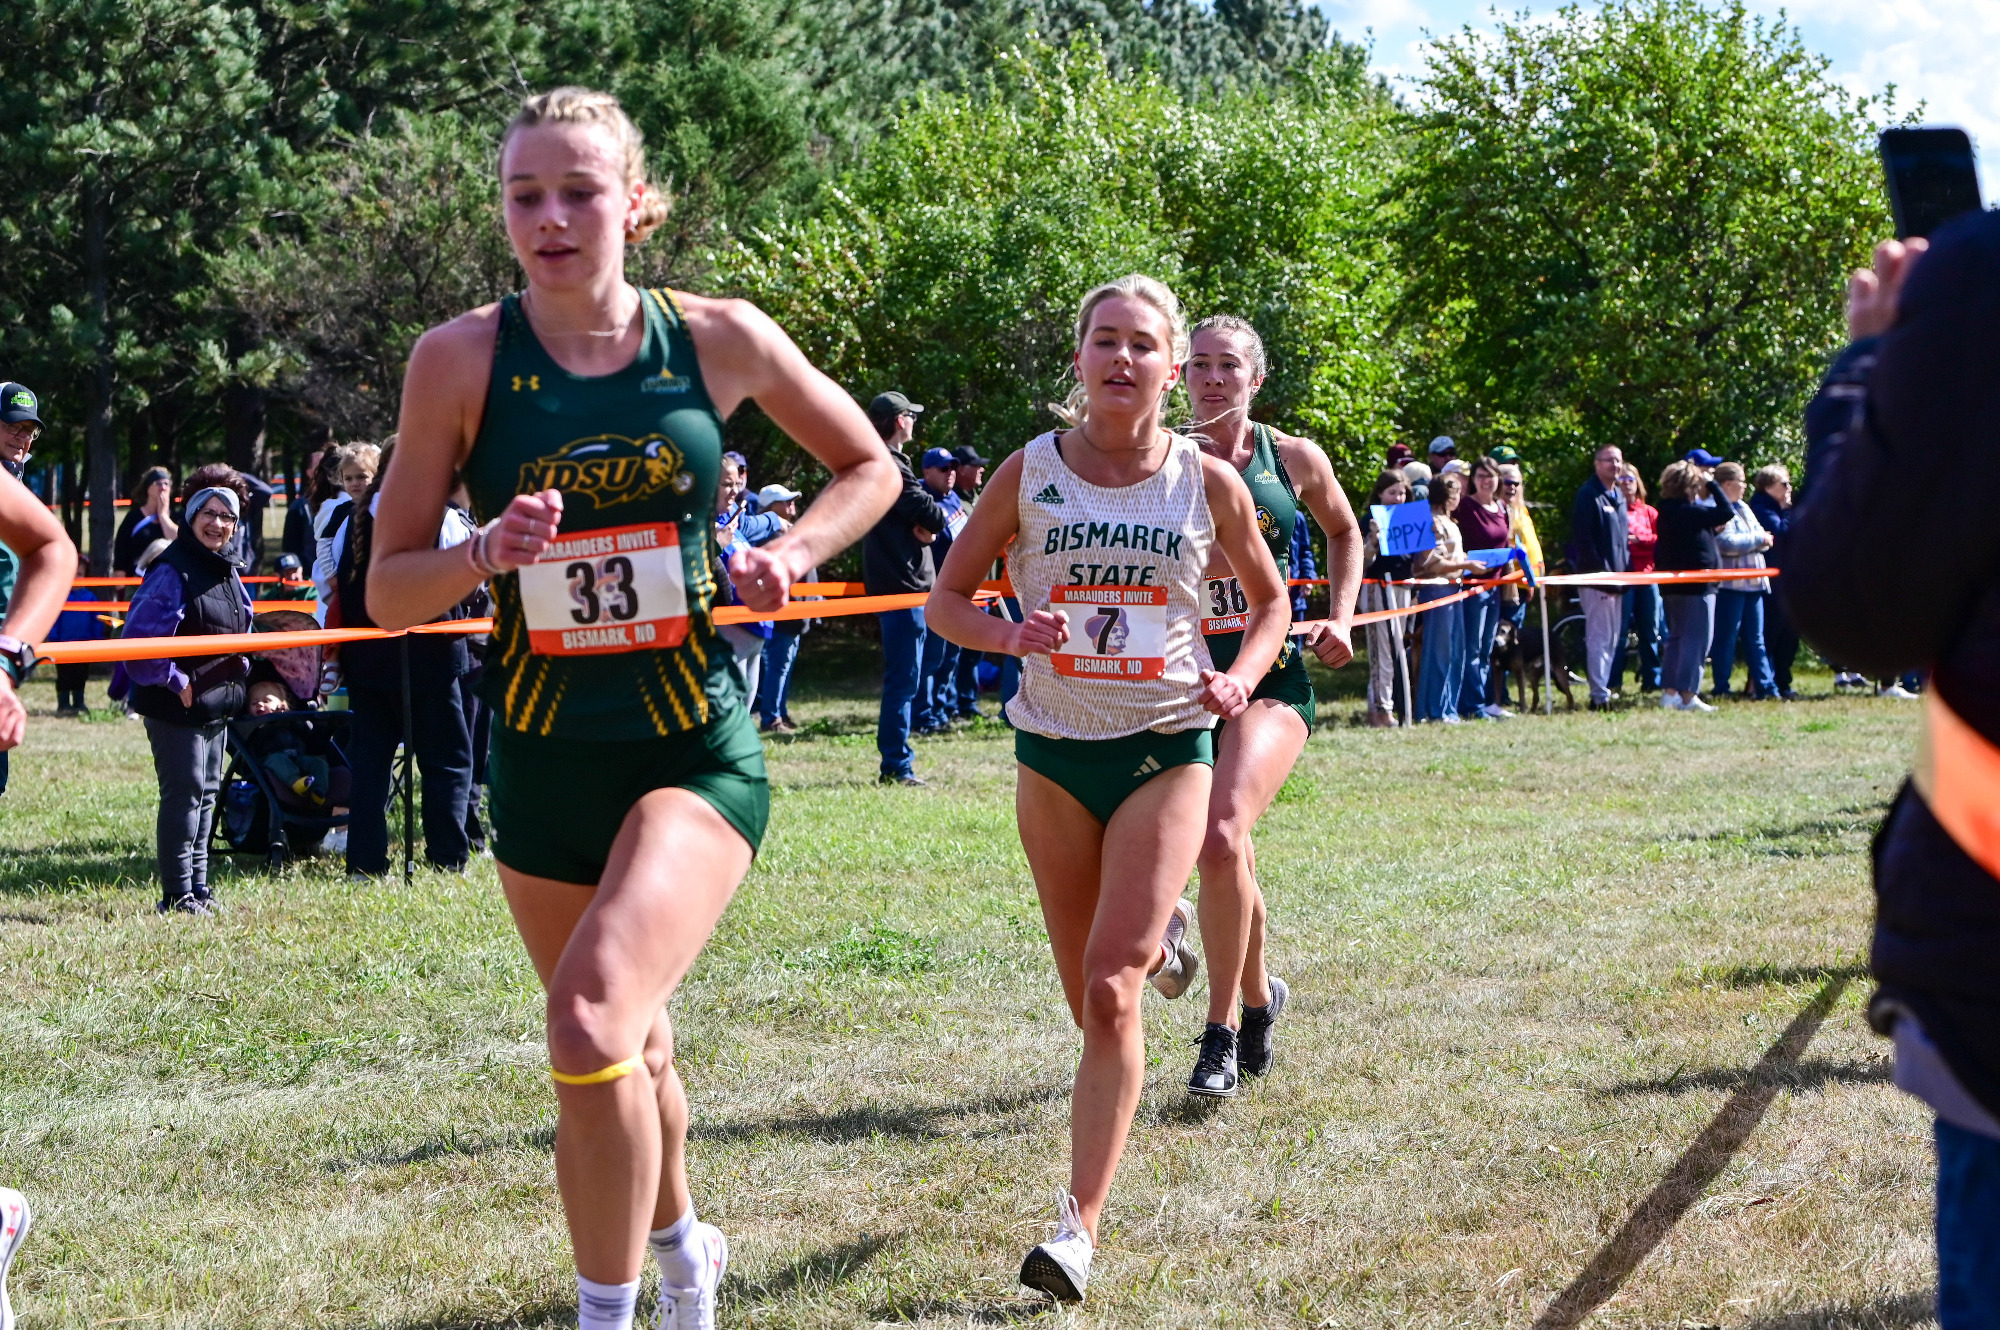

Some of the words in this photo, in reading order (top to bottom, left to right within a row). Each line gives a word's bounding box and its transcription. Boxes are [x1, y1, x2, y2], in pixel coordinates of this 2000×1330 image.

[517, 457, 641, 494] NDSU
[617, 530, 658, 550] INVITE
[1044, 521, 1183, 561] BISMARCK
[1068, 564, 1155, 586] STATE
[566, 556, 638, 624] 33
[1064, 590, 1121, 604] MARAUDERS
[1123, 591, 1154, 604] INVITE
[1208, 577, 1249, 617] 36
[562, 626, 632, 649] BISMARK,
[634, 623, 656, 643] ND
[1097, 607, 1119, 654] 7
[1208, 616, 1244, 631] BISMARK,
[1074, 657, 1124, 675] BISMARK,
[1127, 660, 1142, 674] ND
